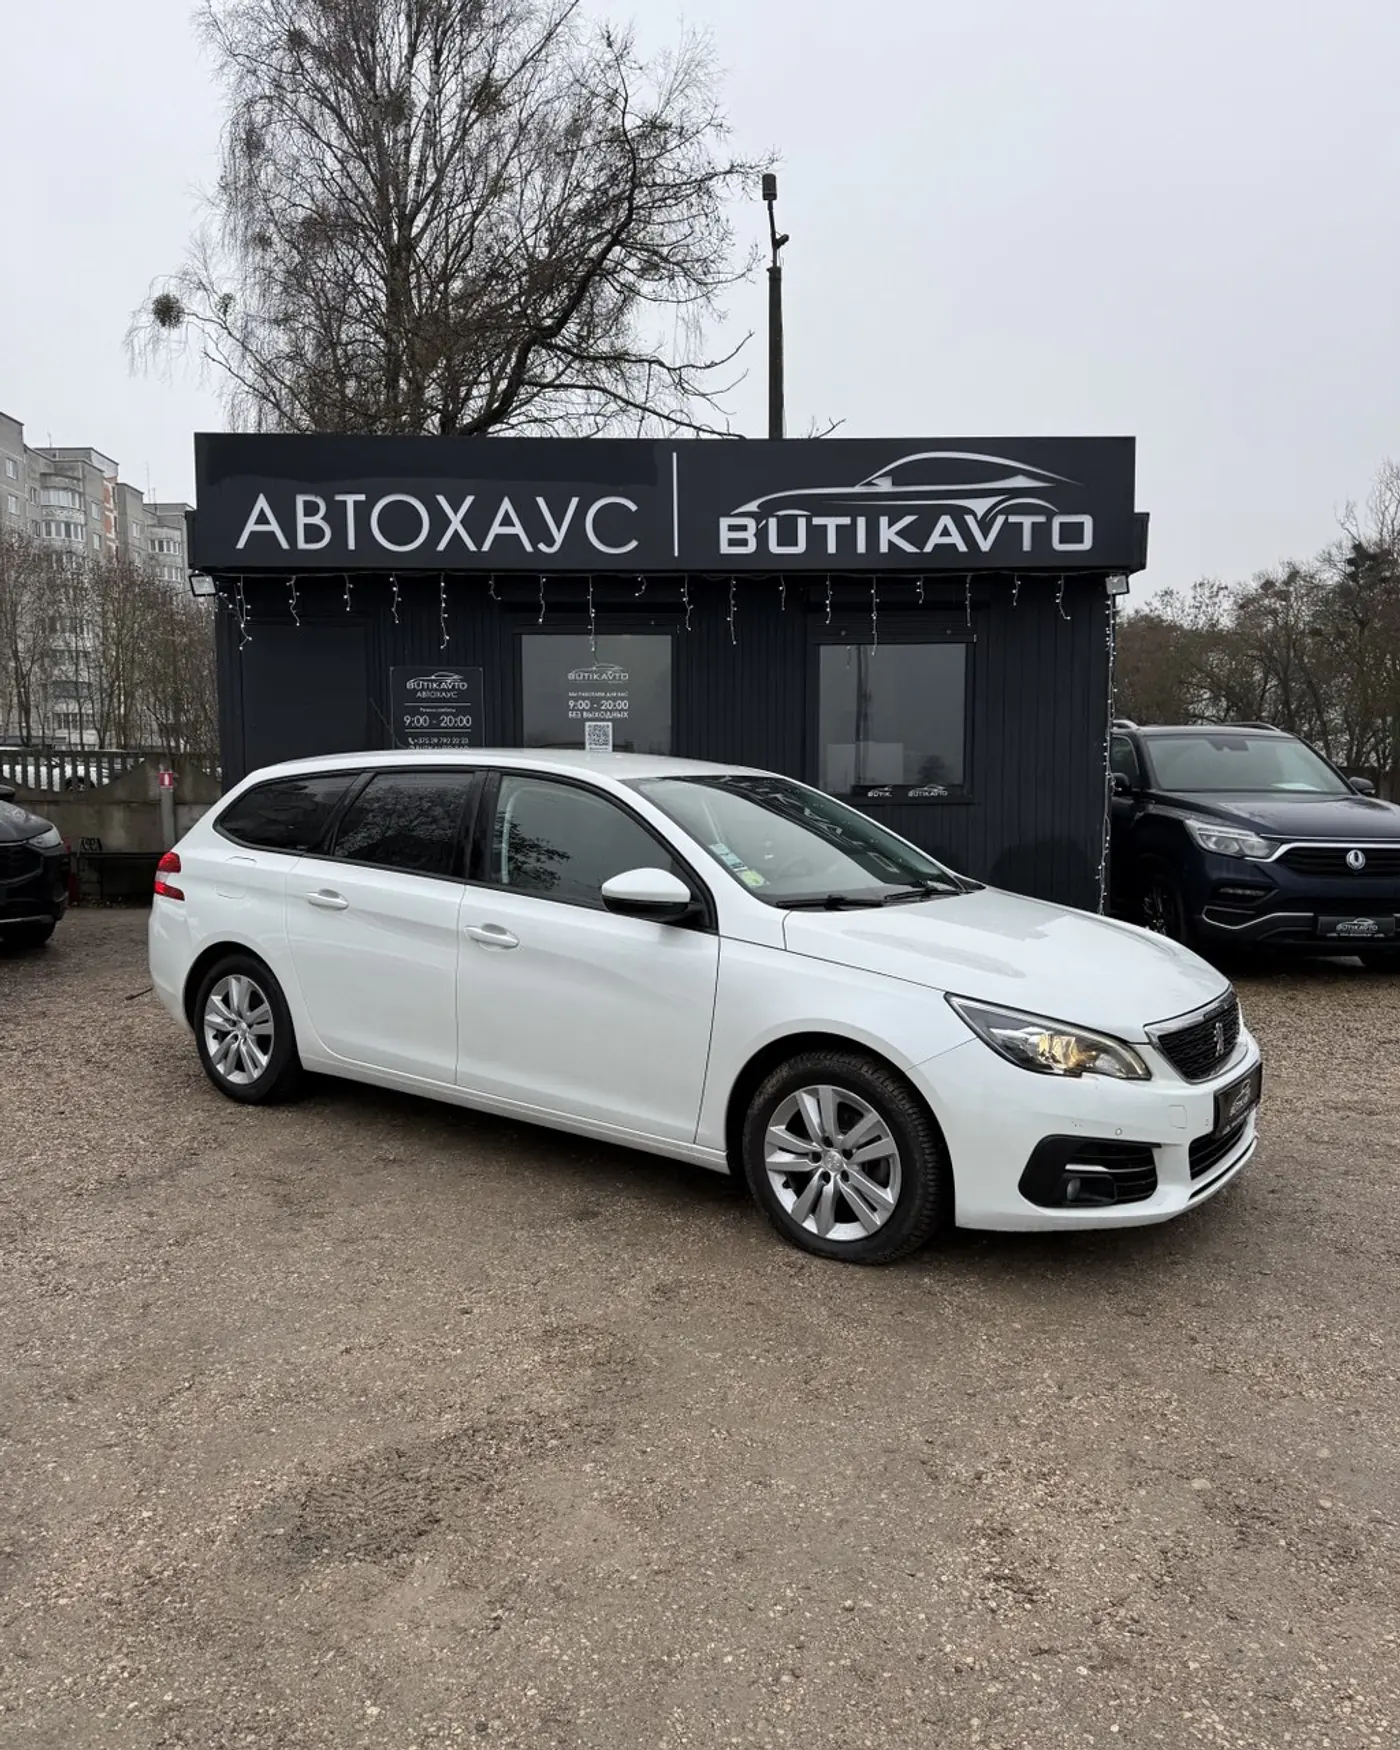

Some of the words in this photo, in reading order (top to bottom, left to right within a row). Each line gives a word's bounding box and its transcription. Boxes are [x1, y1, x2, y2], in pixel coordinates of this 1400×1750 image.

[235, 493, 639, 554] АВТОХАУС
[719, 513, 1093, 554] BUTIKAVTO
[568, 672, 629, 681] BUTIKAVTO
[406, 681, 468, 690] BUTIKAVTO
[416, 691, 458, 699] АВТОХАУС
[568, 700, 590, 710] 9:00
[600, 700, 629, 710] 20:00
[568, 711, 581, 719] БЕЗ
[582, 711, 629, 719] ВЫХОДНЫХ
[403, 715, 430, 727] 9:00
[440, 715, 472, 727] 20:00
